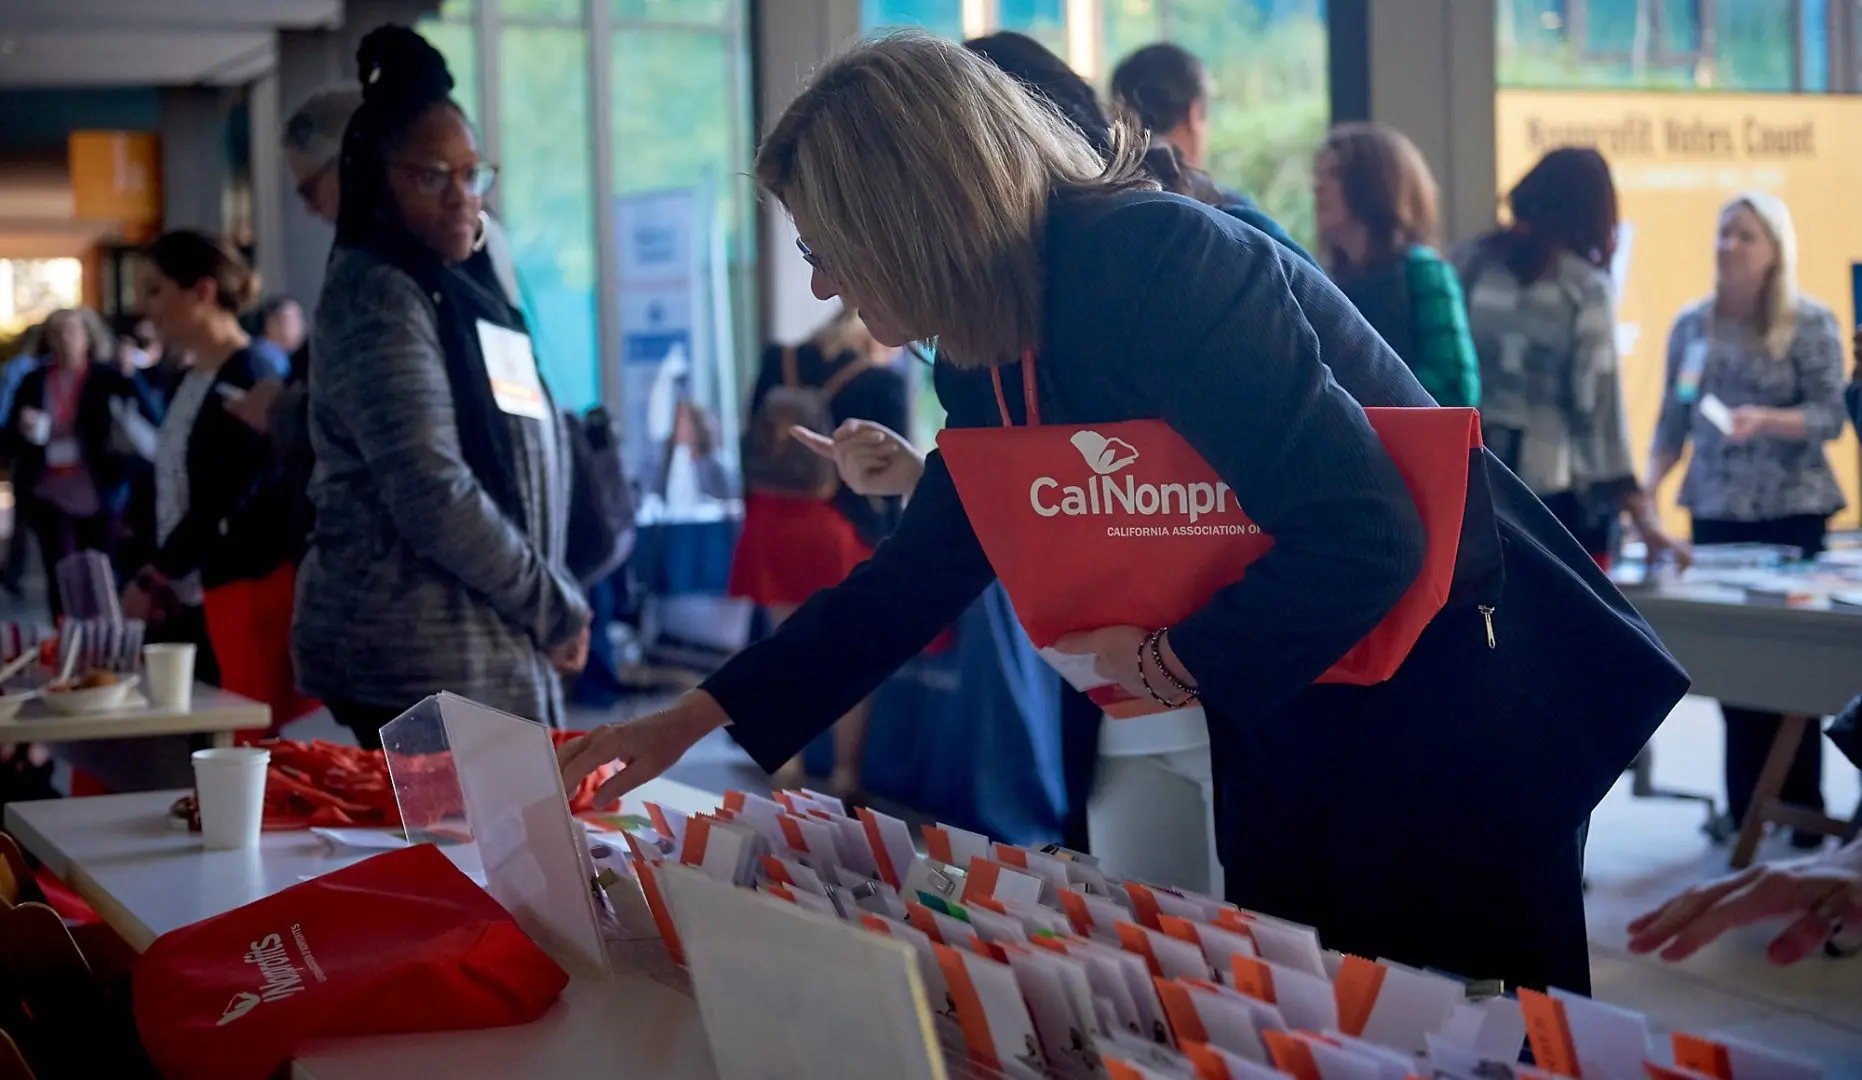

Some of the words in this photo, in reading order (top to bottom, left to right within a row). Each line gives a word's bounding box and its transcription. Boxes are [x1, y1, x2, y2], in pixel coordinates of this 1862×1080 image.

[1664, 114, 1733, 156] Votes
[1743, 113, 1816, 157] Count
[1030, 474, 1242, 523] CalNonpr
[1107, 526, 1169, 537] CALIFORNIA
[1172, 524, 1245, 536] ASSOCIATION
